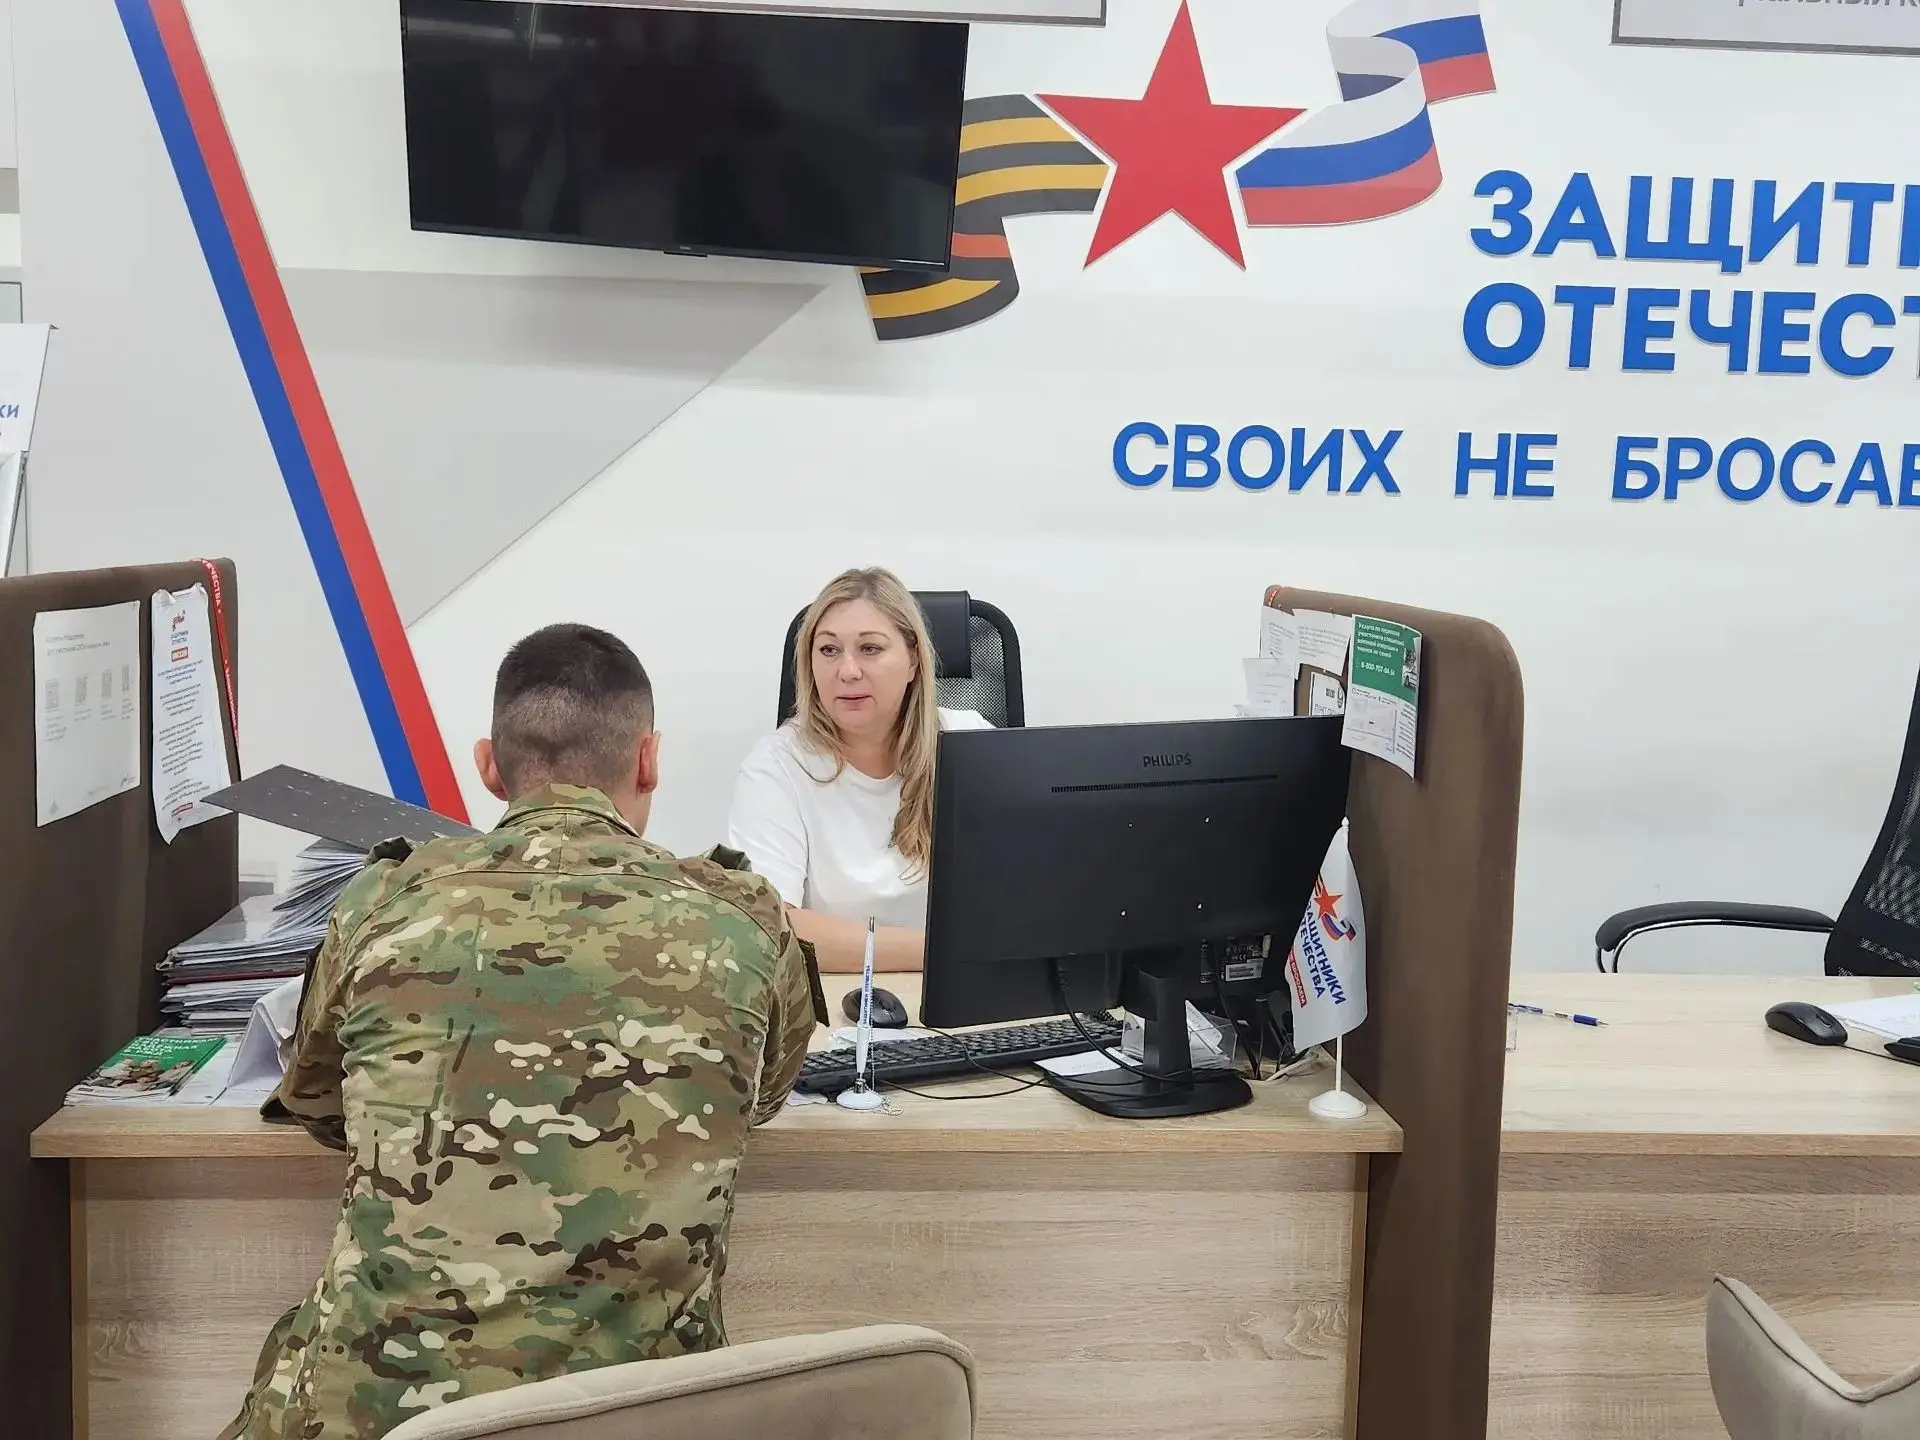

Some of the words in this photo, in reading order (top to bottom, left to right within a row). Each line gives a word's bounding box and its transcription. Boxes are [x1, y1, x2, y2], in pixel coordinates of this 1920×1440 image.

[1112, 422, 1401, 493] СВОИХ
[1455, 432, 1557, 497] НЕ
[1143, 753, 1192, 768] PHILIPS
[1300, 917, 1326, 998] ТЕЧЕСТВА
